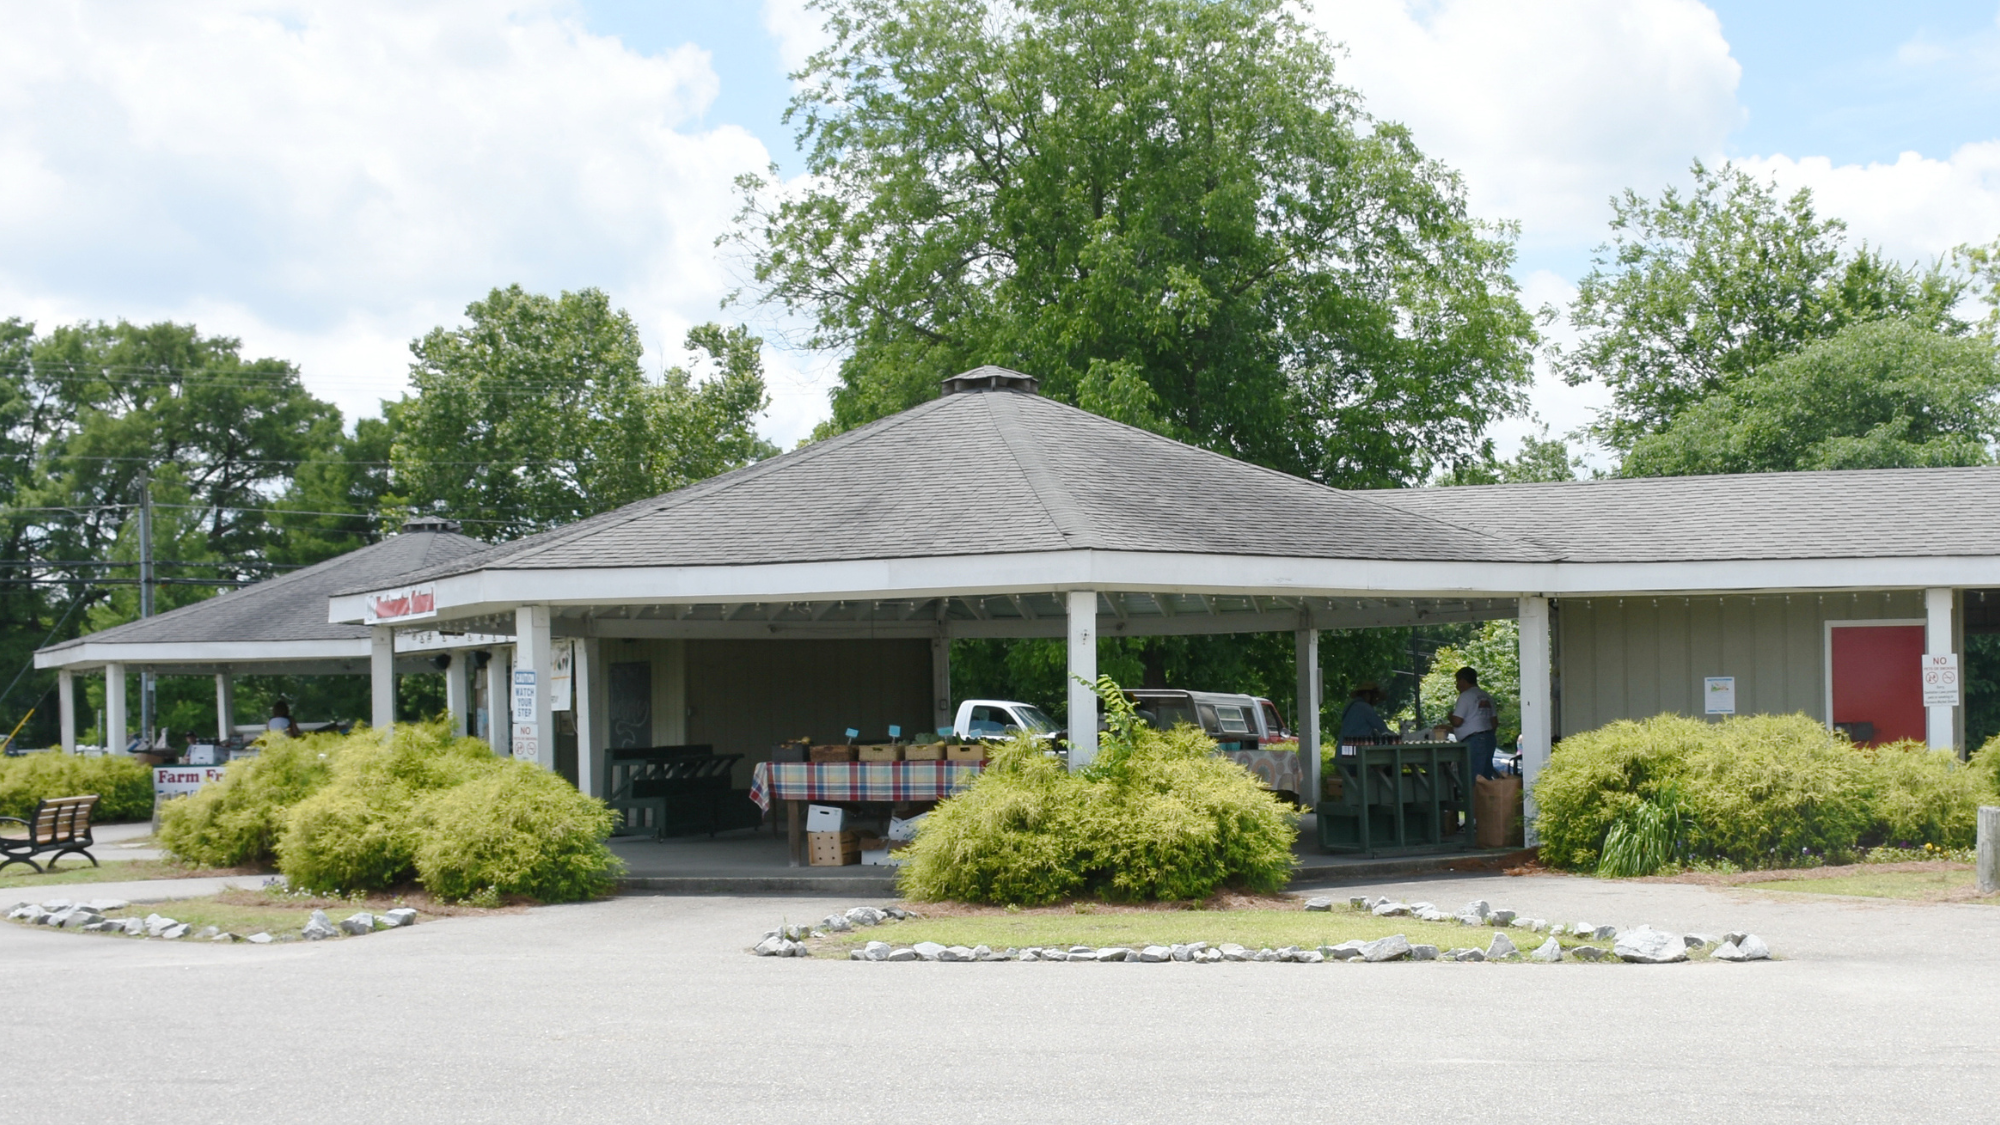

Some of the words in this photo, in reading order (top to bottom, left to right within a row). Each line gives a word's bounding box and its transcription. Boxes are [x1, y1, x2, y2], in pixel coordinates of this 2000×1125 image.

[1932, 656, 1947, 665] NO
[515, 687, 535, 696] WATCH
[517, 698, 532, 707] YOUR
[517, 708, 532, 717] STEP
[520, 726, 531, 735] NO
[158, 769, 200, 784] Farm
[205, 769, 224, 783] Fr
